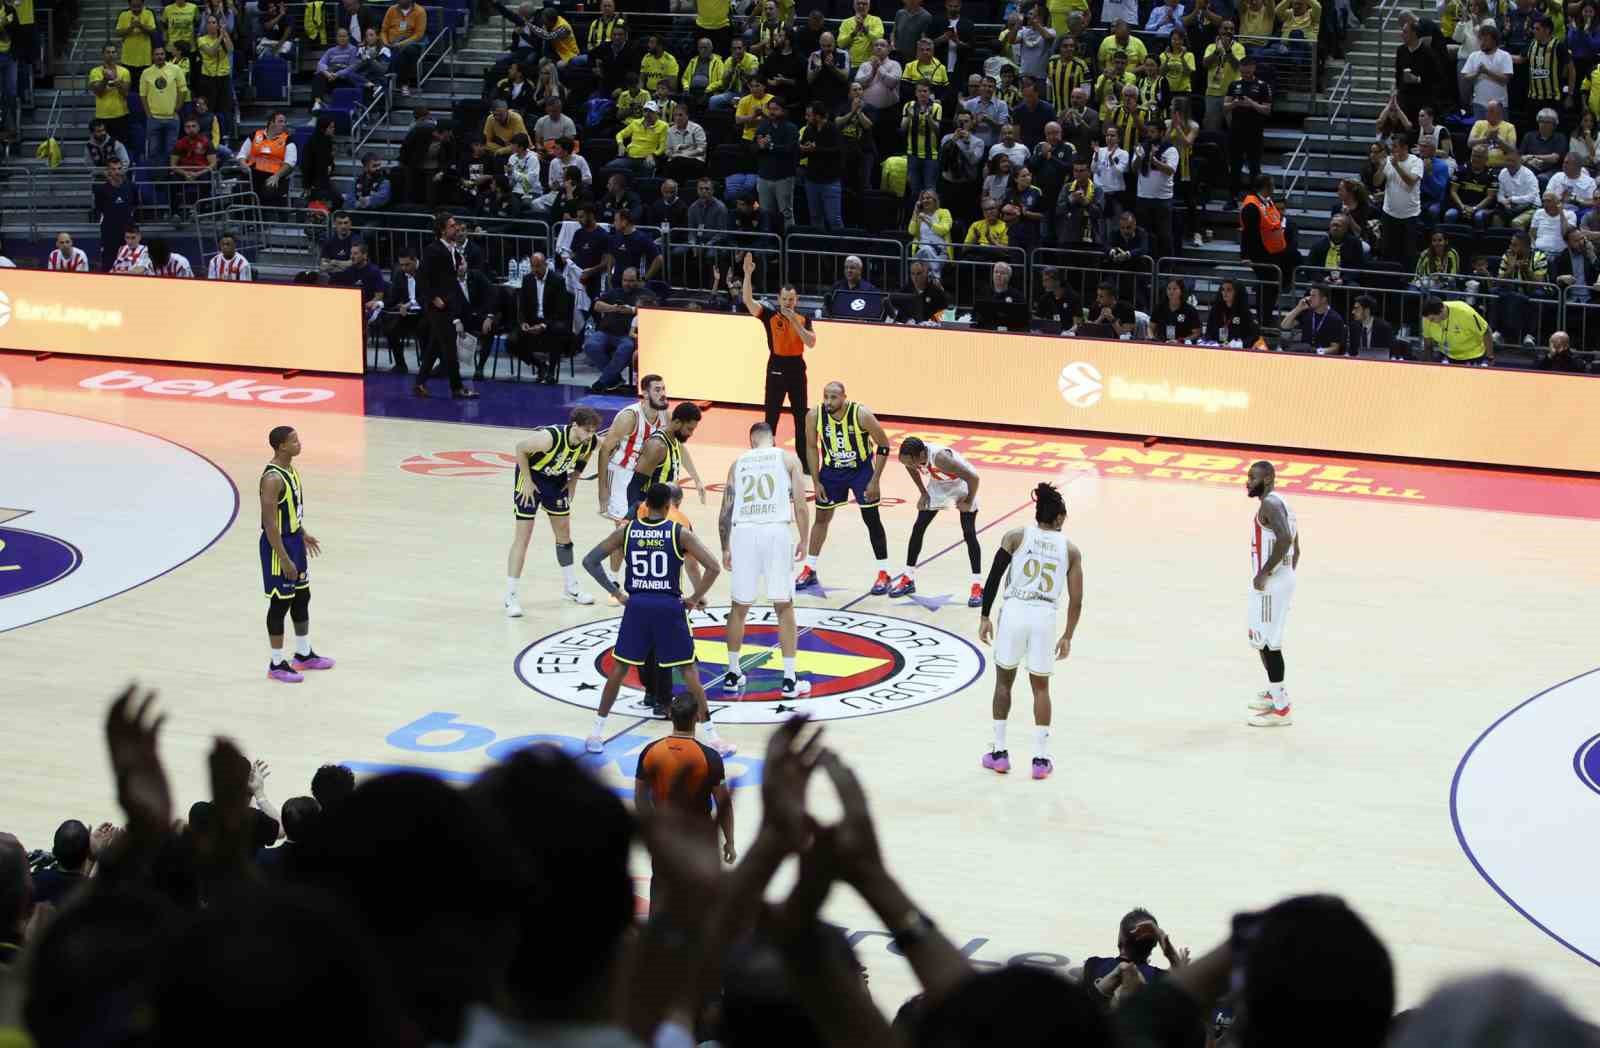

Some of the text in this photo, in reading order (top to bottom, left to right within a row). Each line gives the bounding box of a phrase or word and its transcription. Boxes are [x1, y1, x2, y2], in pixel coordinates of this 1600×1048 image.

[79, 370, 336, 404] beko
[829, 449, 857, 459] beko
[742, 474, 775, 502] 20
[1306, 480, 1425, 500] HALL
[630, 529, 671, 539] COLSON II
[631, 551, 669, 578] 50
[1023, 559, 1056, 593] 95
[818, 615, 940, 649] SPOR
